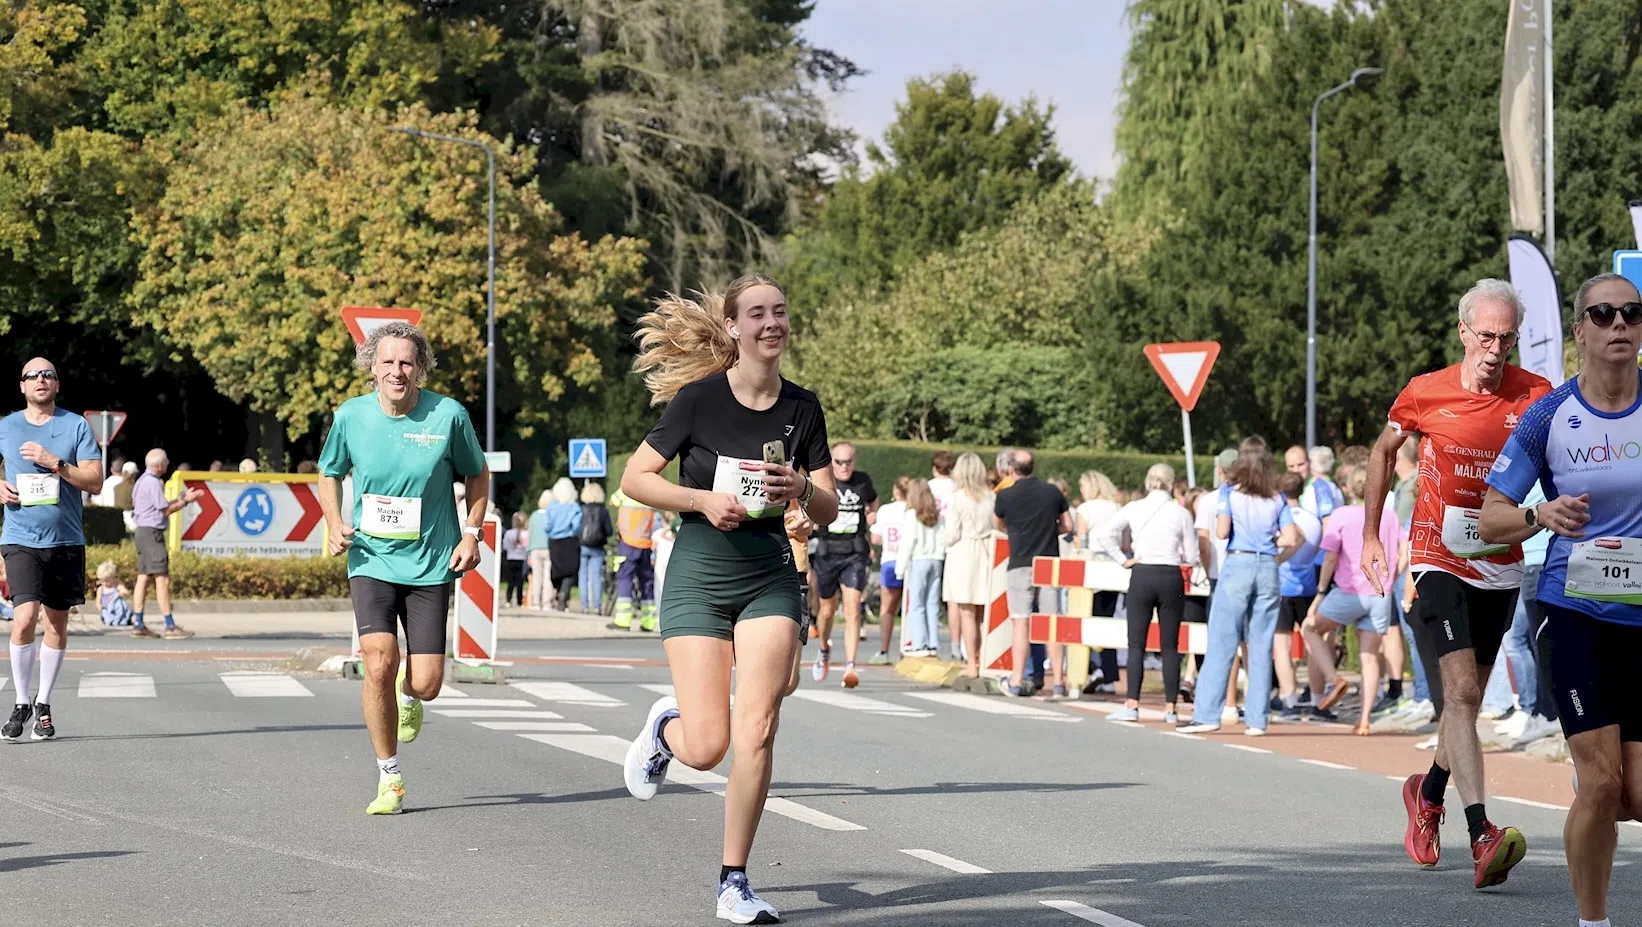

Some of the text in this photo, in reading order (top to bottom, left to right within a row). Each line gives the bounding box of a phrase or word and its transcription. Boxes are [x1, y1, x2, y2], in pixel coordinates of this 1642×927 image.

[1455, 446, 1496, 459] GENERALI
[1566, 433, 1642, 464] walvo
[1454, 463, 1489, 480] MÁLAG
[1568, 465, 1612, 473] ontwikkelaars
[741, 476, 767, 486] Nynk
[376, 507, 404, 516] Machel
[380, 514, 399, 524] 873
[1464, 530, 1482, 541] 10
[1585, 555, 1608, 563] Walvoort
[1602, 565, 1630, 580] 101
[1442, 619, 1455, 641] FUSION
[1569, 689, 1585, 717] FUSION
